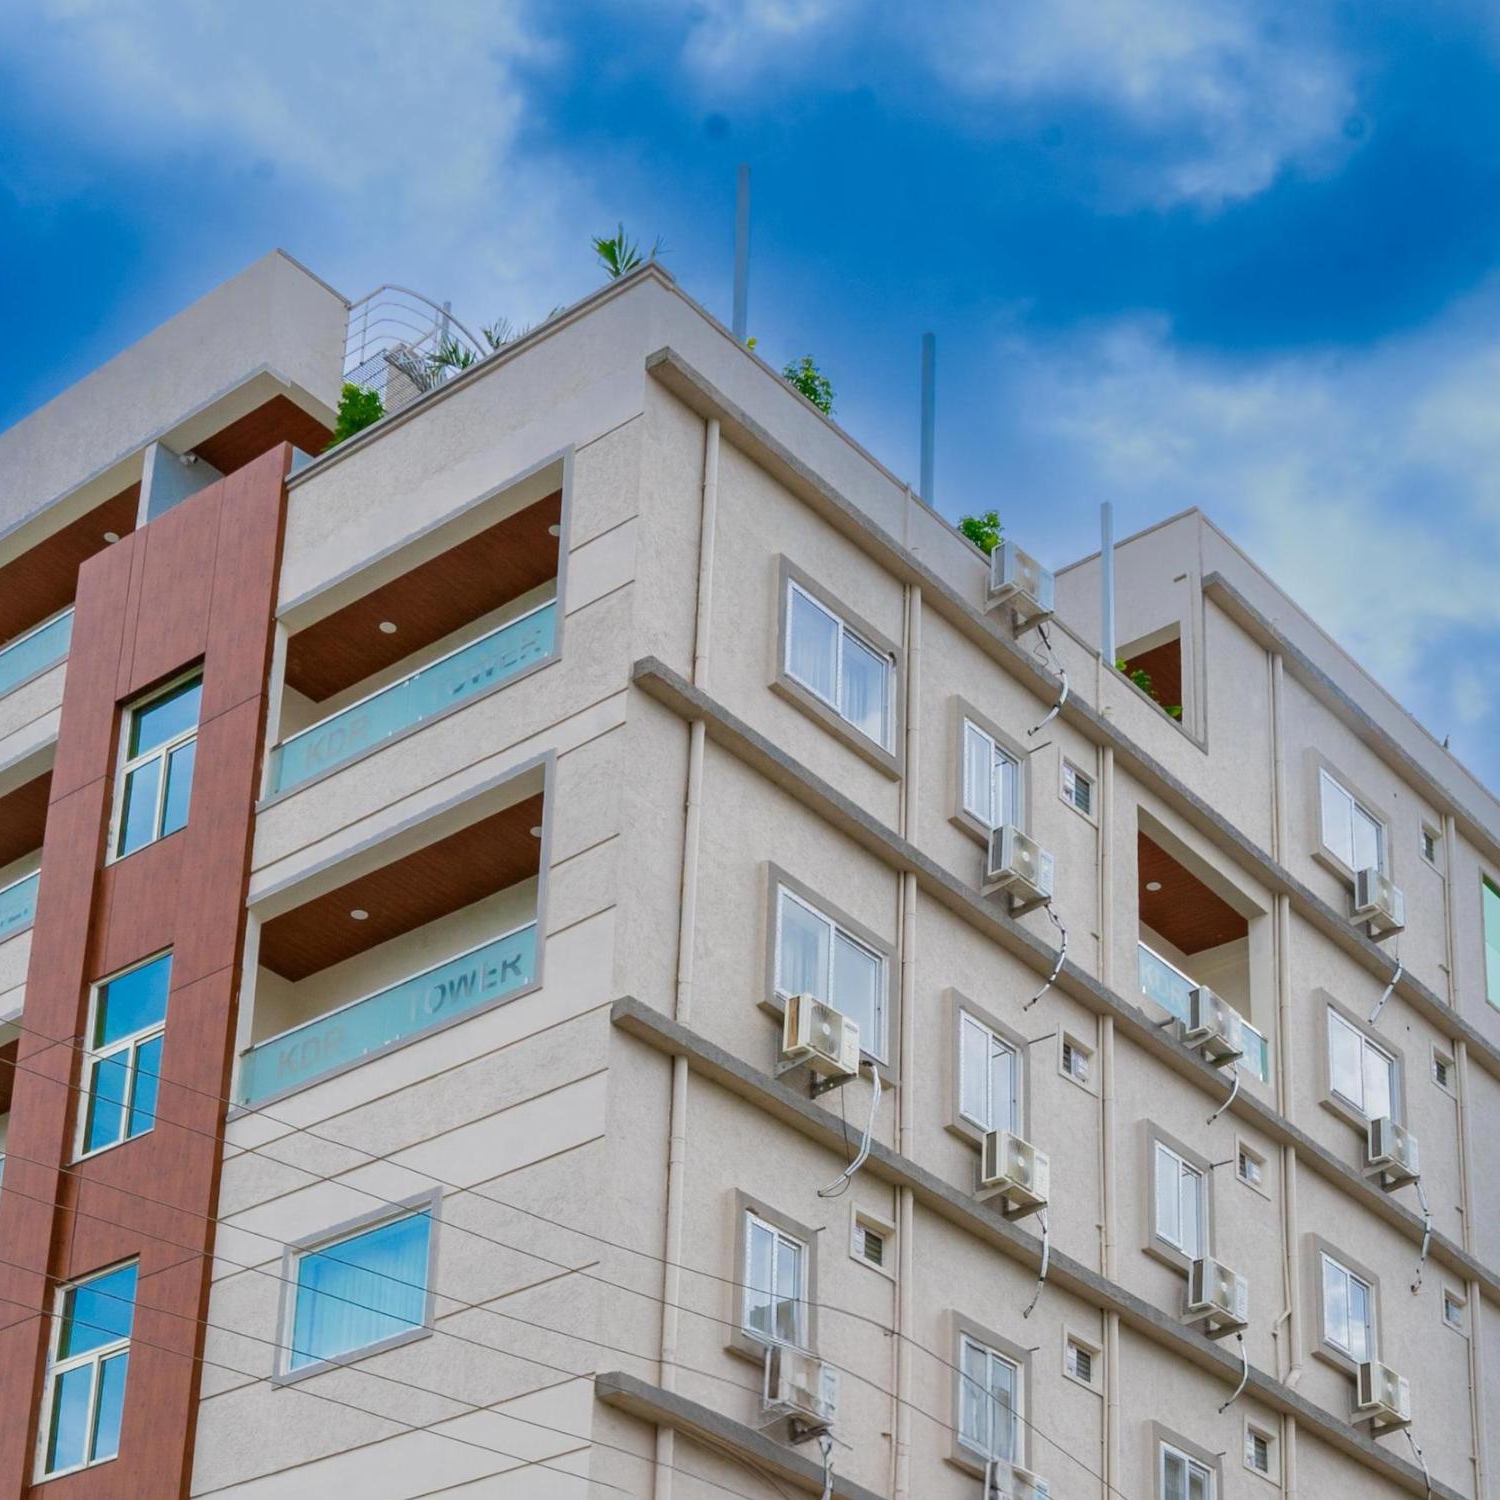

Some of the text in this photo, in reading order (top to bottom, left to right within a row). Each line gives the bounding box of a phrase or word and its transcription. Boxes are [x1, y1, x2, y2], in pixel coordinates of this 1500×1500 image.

[304, 714, 368, 770] KDR
[276, 949, 523, 1081] KDR TOWER
